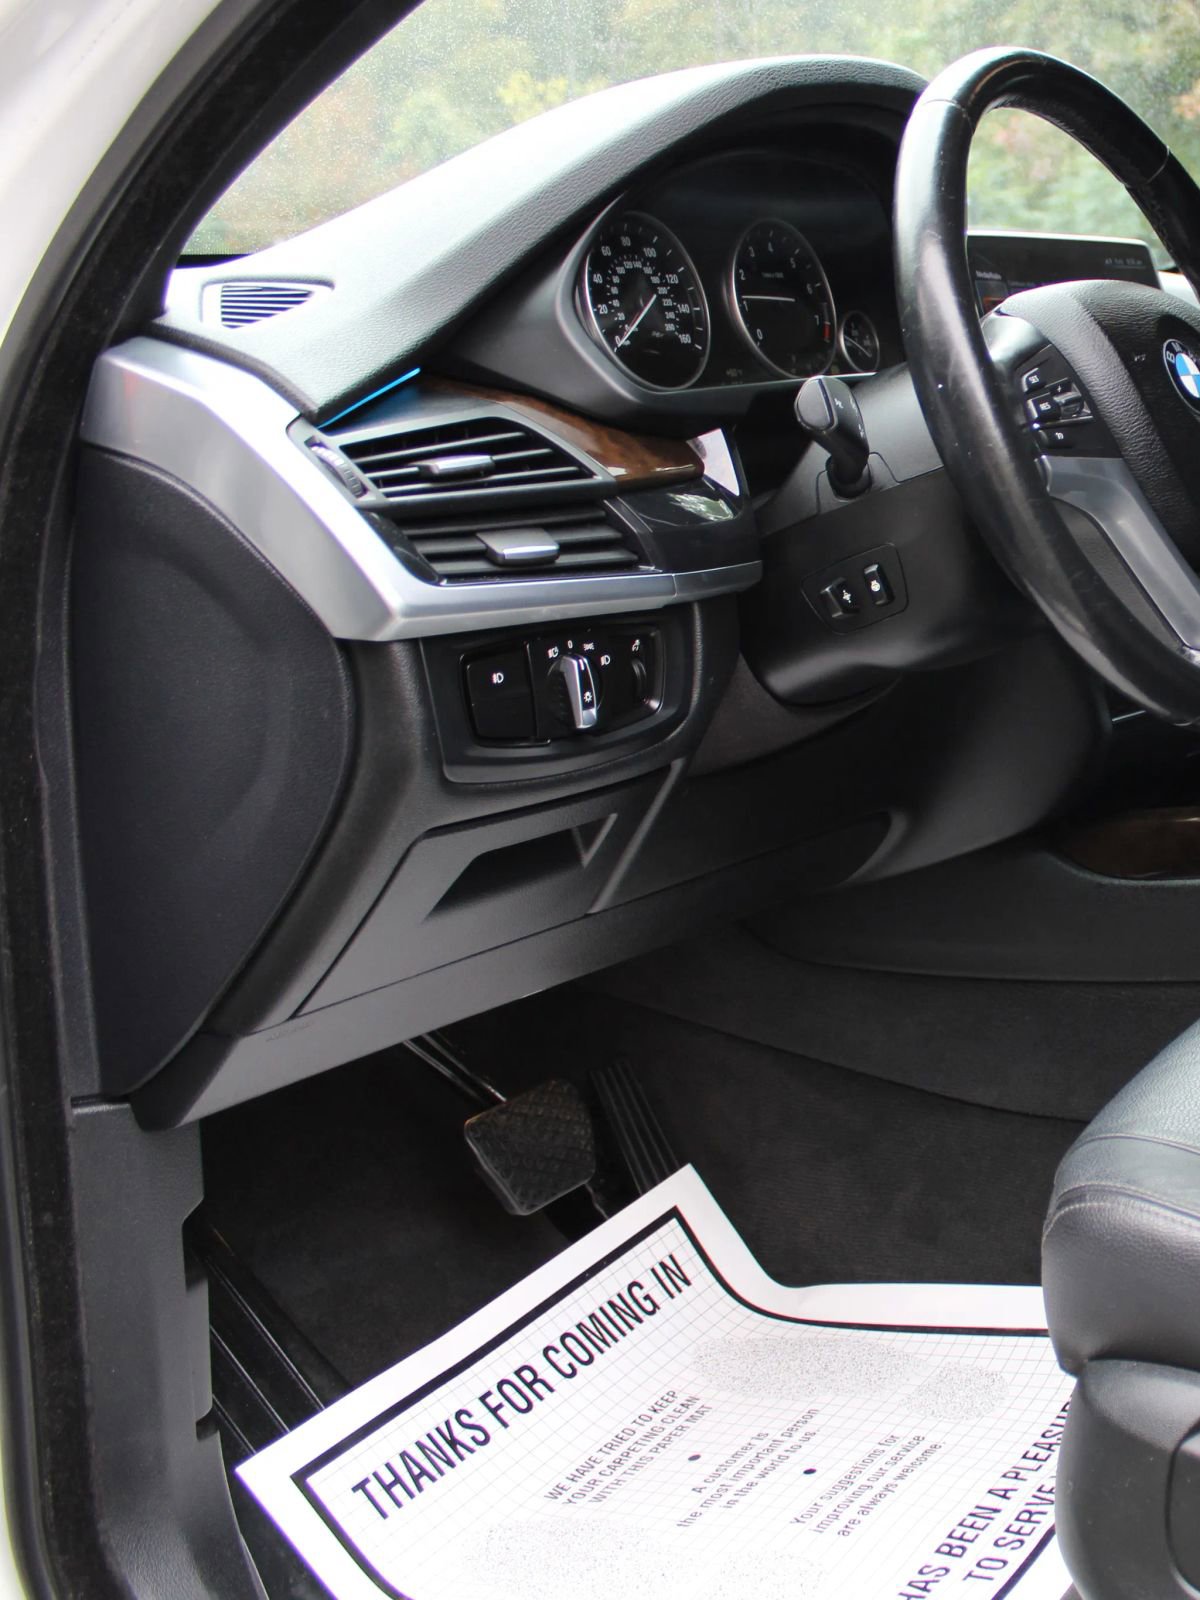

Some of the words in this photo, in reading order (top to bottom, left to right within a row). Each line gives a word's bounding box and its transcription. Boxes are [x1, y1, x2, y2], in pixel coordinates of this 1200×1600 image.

[593, 273, 603, 283] 40
[601, 246, 611, 256] 60
[643, 248, 656, 258] 100
[739, 269, 746, 280] 2
[666, 274, 678, 284] 120
[597, 304, 608, 314] 20
[677, 304, 690, 314] 140
[756, 328, 763, 340] 0
[678, 333, 691, 344] 160
[351, 1409, 491, 1519] THANKS
[478, 1364, 555, 1428] FOR
[543, 1281, 661, 1380] COMING
[650, 1254, 692, 1299] IN
[544, 1483, 570, 1501] WE
[566, 1455, 601, 1483] HAVE
[597, 1427, 636, 1455] TRIED
[631, 1414, 653, 1427] TO
[648, 1390, 679, 1414] KEEP
[562, 1478, 603, 1505] YOUR
[600, 1425, 665, 1477] CARPETING
[661, 1396, 700, 1424] CLEAN
[588, 1478, 627, 1503] WITH
[621, 1455, 654, 1477] THIS
[650, 1424, 690, 1454] PAPER
[685, 1404, 713, 1423] MAT
[691, 1486, 707, 1494] A
[704, 1442, 757, 1484] customer
[751, 1433, 769, 1442] is
[867, 1467, 889, 1484] our
[885, 1435, 926, 1467] service
[1001, 1394, 1073, 1481] PLEAS
[677, 1511, 702, 1527] the
[700, 1483, 733, 1508] most
[729, 1439, 785, 1482] important
[781, 1408, 820, 1438] person
[720, 1499, 739, 1509] in
[734, 1481, 758, 1497] the
[755, 1454, 789, 1479] world
[784, 1444, 802, 1453] to
[789, 1502, 823, 1526] Your
[820, 1449, 886, 1501] suggestions
[878, 1434, 901, 1447] for
[987, 1487, 1019, 1501] A
[837, 1518, 861, 1537] are
[857, 1483, 899, 1517] always
[934, 1504, 1003, 1559] BEEN
[962, 1557, 1009, 1581] TO
[992, 1484, 1056, 1551] SERVE
